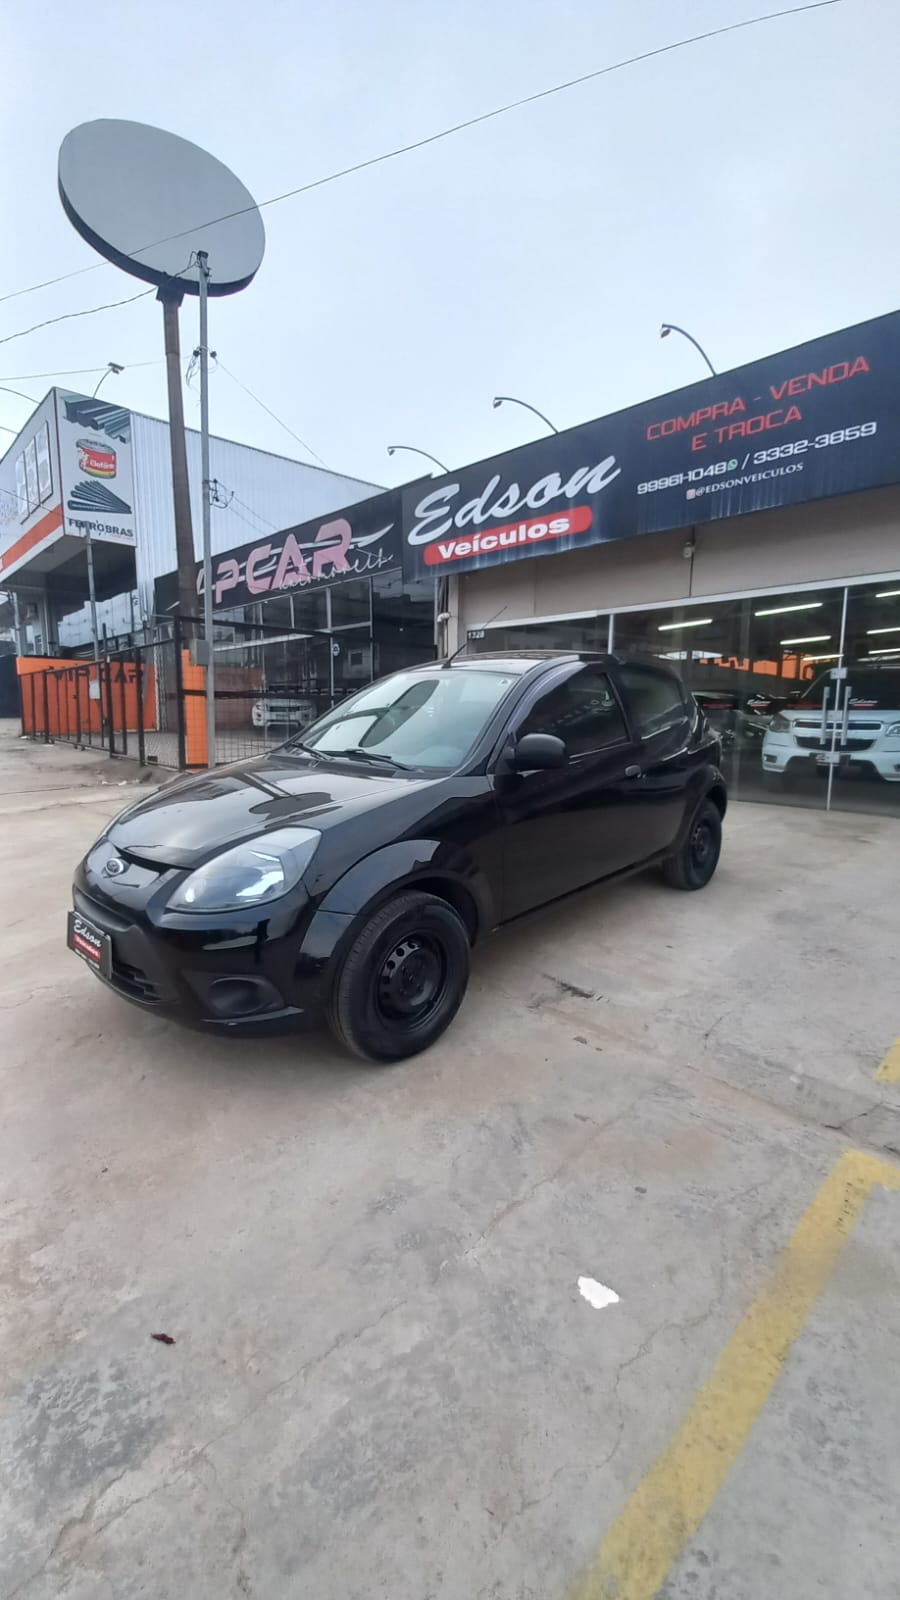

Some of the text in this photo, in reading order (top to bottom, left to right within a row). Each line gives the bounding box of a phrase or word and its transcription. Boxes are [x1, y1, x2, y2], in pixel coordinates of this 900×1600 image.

[646, 396, 747, 441] COMPRA
[769, 356, 871, 401] VENDA
[691, 405, 803, 452] E TROCA
[753, 421, 877, 465] 3332-3859
[407, 455, 622, 546] Edson
[695, 462, 804, 497] @EDSONVEICULOS
[438, 517, 571, 560] Veículos
